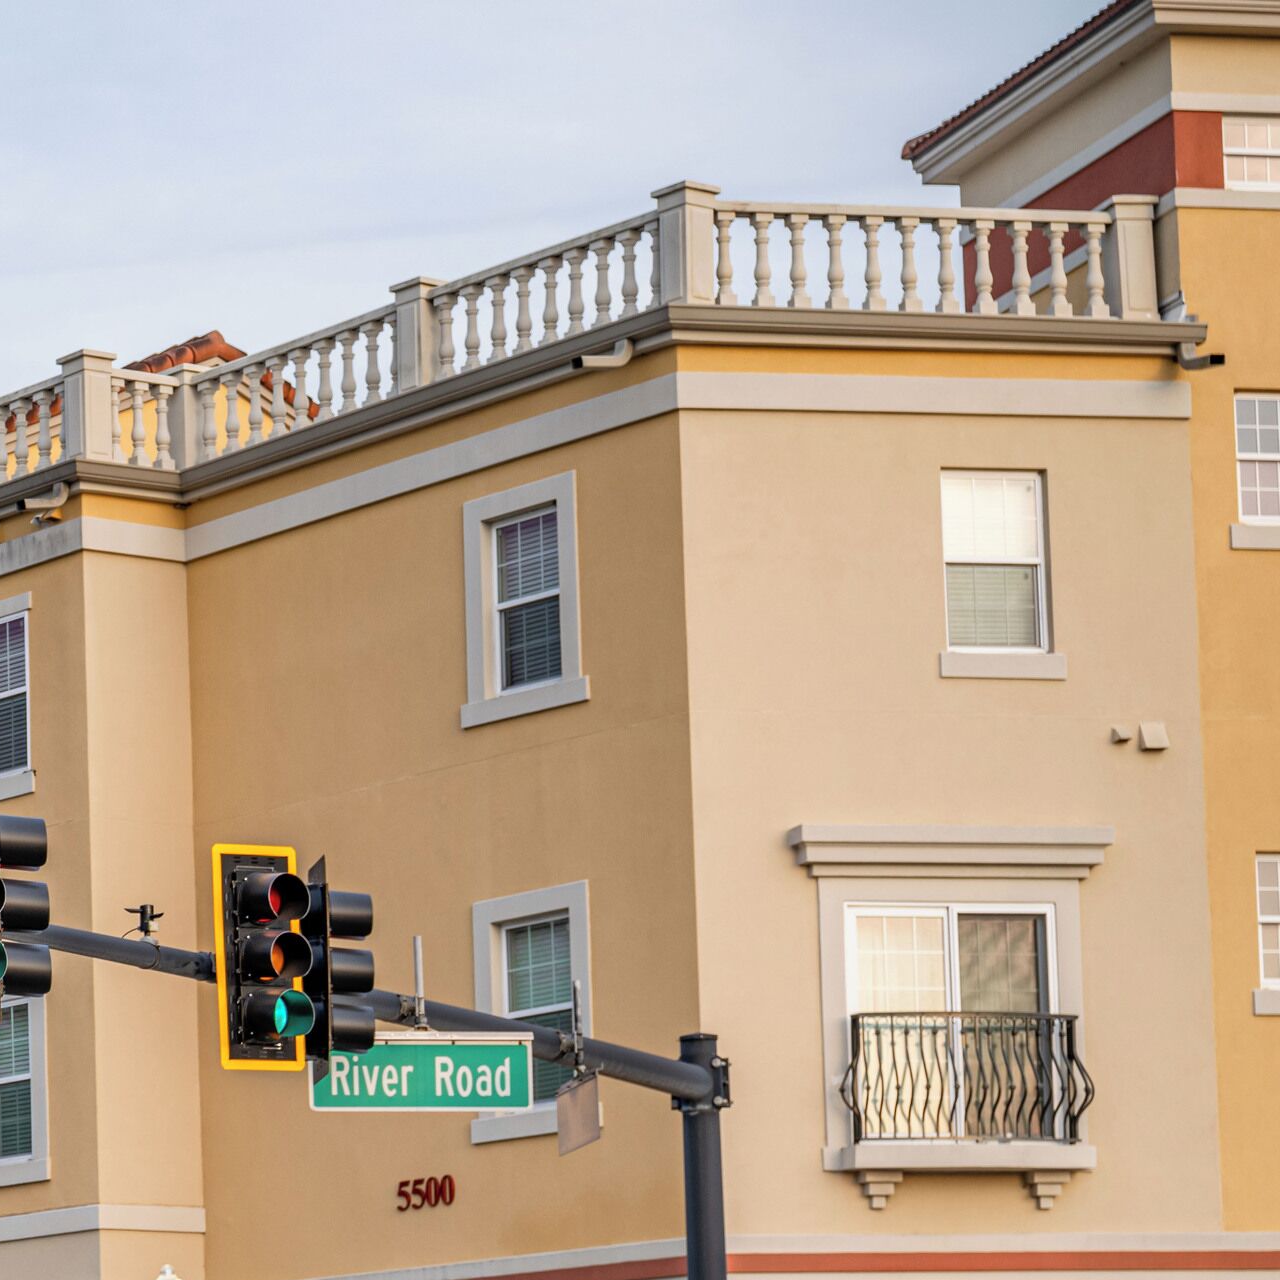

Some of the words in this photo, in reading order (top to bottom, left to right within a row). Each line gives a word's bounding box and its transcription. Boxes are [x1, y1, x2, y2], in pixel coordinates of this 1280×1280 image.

[330, 1055, 414, 1097] River
[434, 1055, 511, 1098] Road
[396, 1173, 455, 1212] 5500
